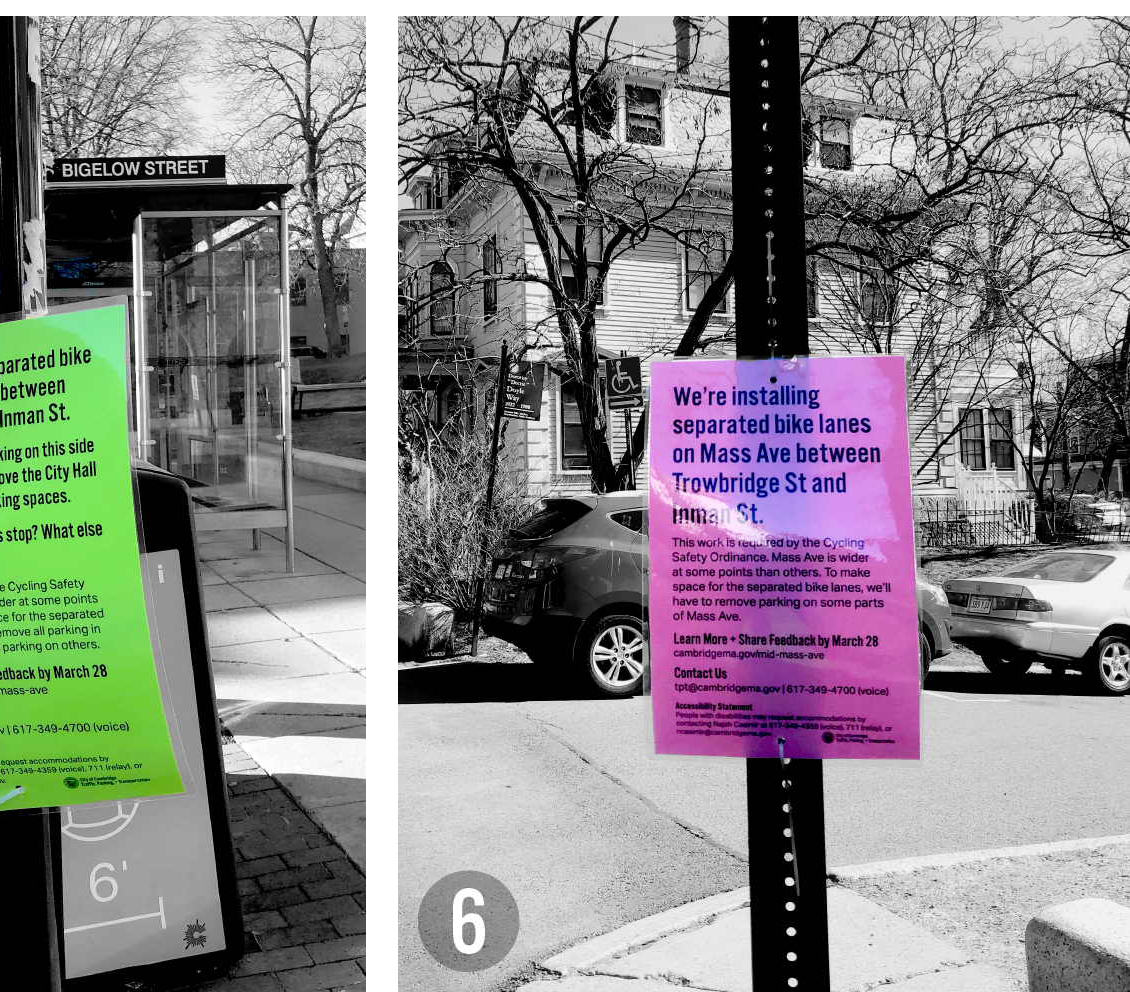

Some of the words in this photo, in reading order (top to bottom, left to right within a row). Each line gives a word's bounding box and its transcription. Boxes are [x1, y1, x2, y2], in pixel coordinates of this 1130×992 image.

[62, 162, 140, 177] BIGELOW
[145, 160, 208, 175] STREET
[60, 346, 91, 367] bike
[0, 379, 66, 401] between
[506, 394, 519, 402] Way
[507, 386, 525, 394] Doyle
[673, 387, 727, 406] We're
[732, 386, 820, 408] installing
[0, 407, 44, 428] Inman
[49, 402, 70, 422] St.
[673, 415, 769, 438] separated
[775, 415, 814, 433] bike
[819, 414, 871, 433] lanes
[673, 446, 694, 463] on
[700, 443, 751, 463] Mass
[756, 443, 790, 463] Ave
[796, 443, 881, 463] between
[672, 472, 779, 497] Trowbridge
[785, 473, 807, 493] St
[812, 473, 847, 493] and
[737, 503, 764, 524] St.
[672, 552, 707, 564] Safety
[710, 553, 769, 562] Ordinance.
[772, 553, 800, 562] Mass
[804, 553, 824, 562] Ave
[827, 553, 836, 562] is
[838, 553, 869, 562] wider
[674, 649, 824, 660] cambridgema.gov/mid-mass-ave
[38, 666, 51, 681] by
[53, 664, 89, 678] March
[93, 664, 107, 677] 28
[674, 667, 712, 679] Contact
[715, 668, 727, 679] Us
[13, 723, 90, 734] 617-349-4700
[93, 722, 129, 732] (voice)
[89, 860, 128, 902] 6'
